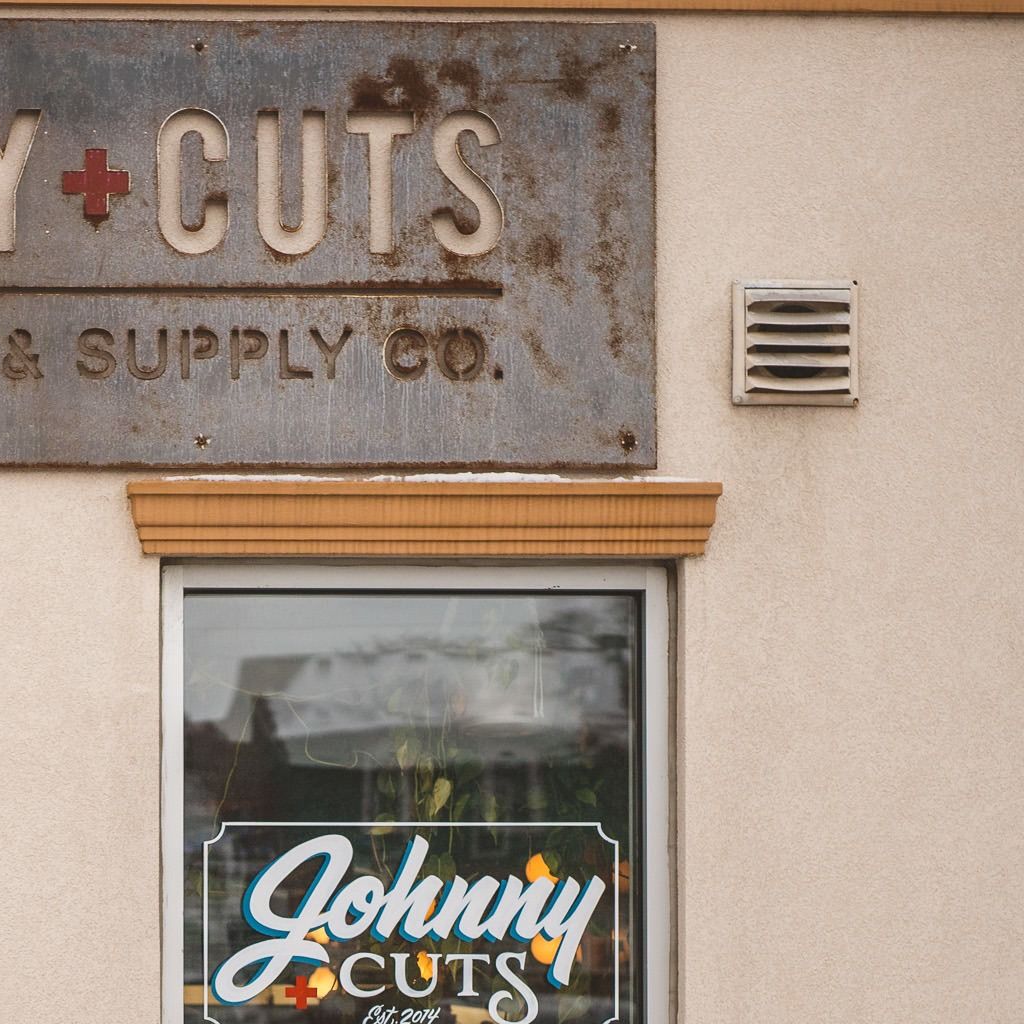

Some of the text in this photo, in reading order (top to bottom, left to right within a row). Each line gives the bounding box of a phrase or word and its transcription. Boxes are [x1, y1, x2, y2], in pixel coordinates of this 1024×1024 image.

[156, 107, 504, 256] CUTS
[2, 328, 44, 380] &
[76, 326, 353, 380] SUPPLY
[382, 327, 503, 382] CO.
[212, 834, 606, 1006] Johnny
